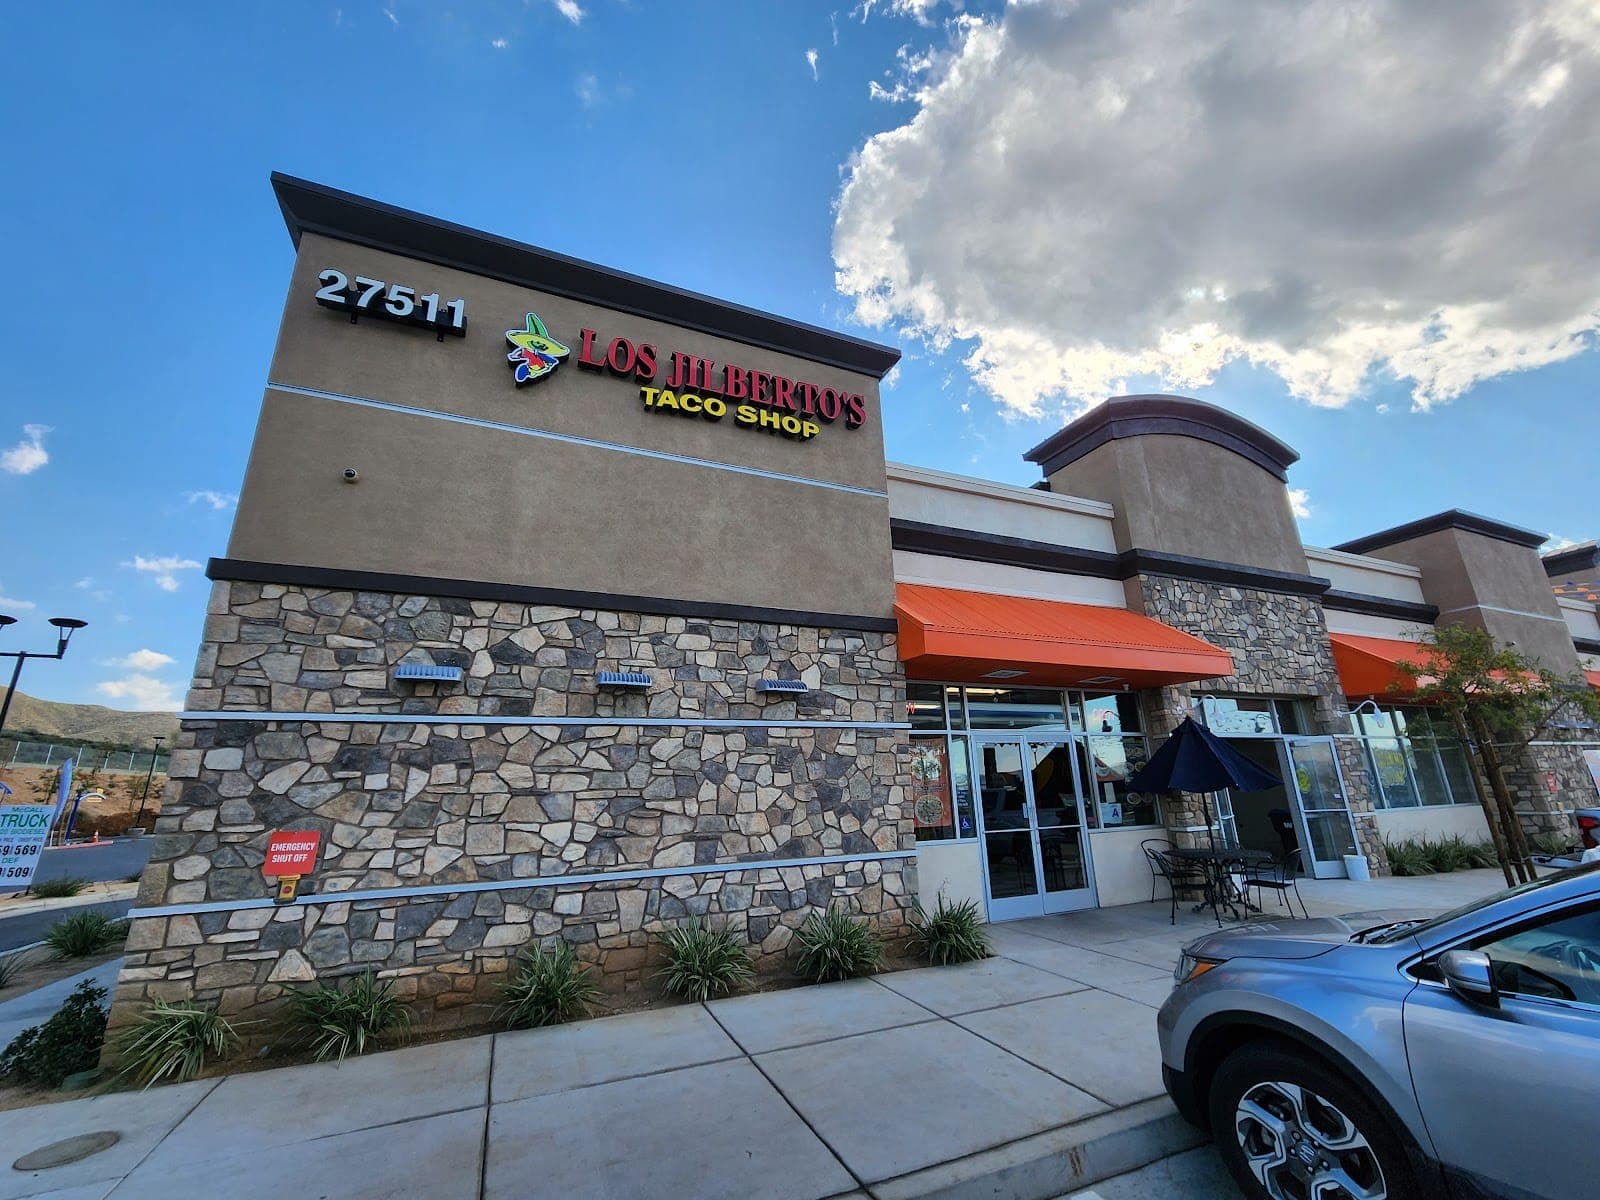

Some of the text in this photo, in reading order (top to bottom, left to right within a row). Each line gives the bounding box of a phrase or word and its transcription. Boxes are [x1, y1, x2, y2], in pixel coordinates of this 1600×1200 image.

[314, 268, 465, 328] 27511
[577, 328, 867, 427] LOS JILBERTO'S
[640, 386, 821, 439] TACO SHOP
[1112, 807, 1119, 817] A
[0, 813, 50, 828] TRUCK
[271, 842, 315, 851] EMERGENCY
[271, 853, 307, 863] SHUT OFF
